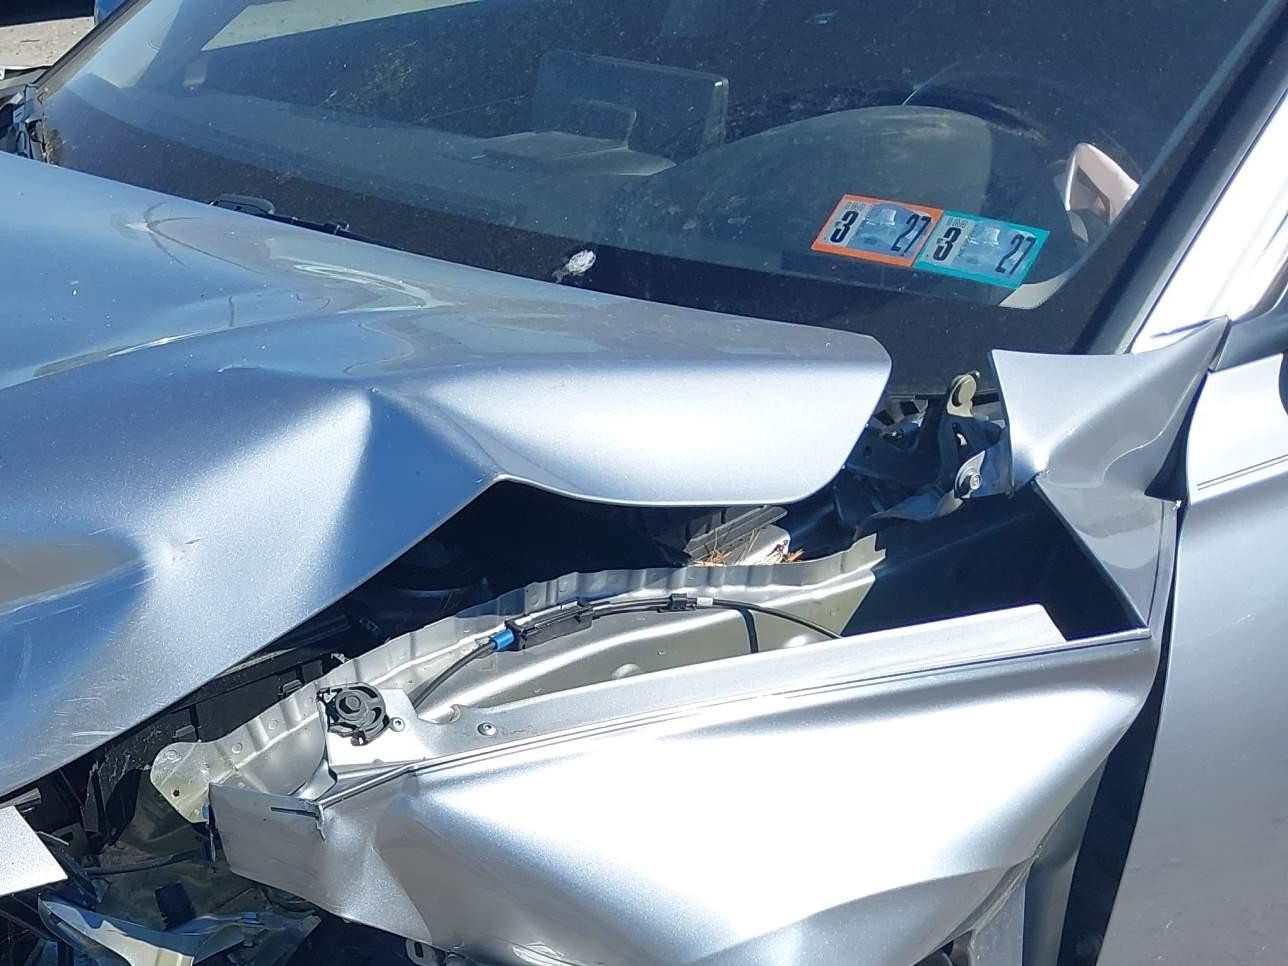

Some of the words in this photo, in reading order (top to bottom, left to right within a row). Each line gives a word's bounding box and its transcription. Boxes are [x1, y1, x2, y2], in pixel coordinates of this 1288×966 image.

[830, 210, 859, 243] 3
[890, 213, 932, 254] 27
[932, 226, 962, 261] 3
[995, 233, 1037, 275] 27
